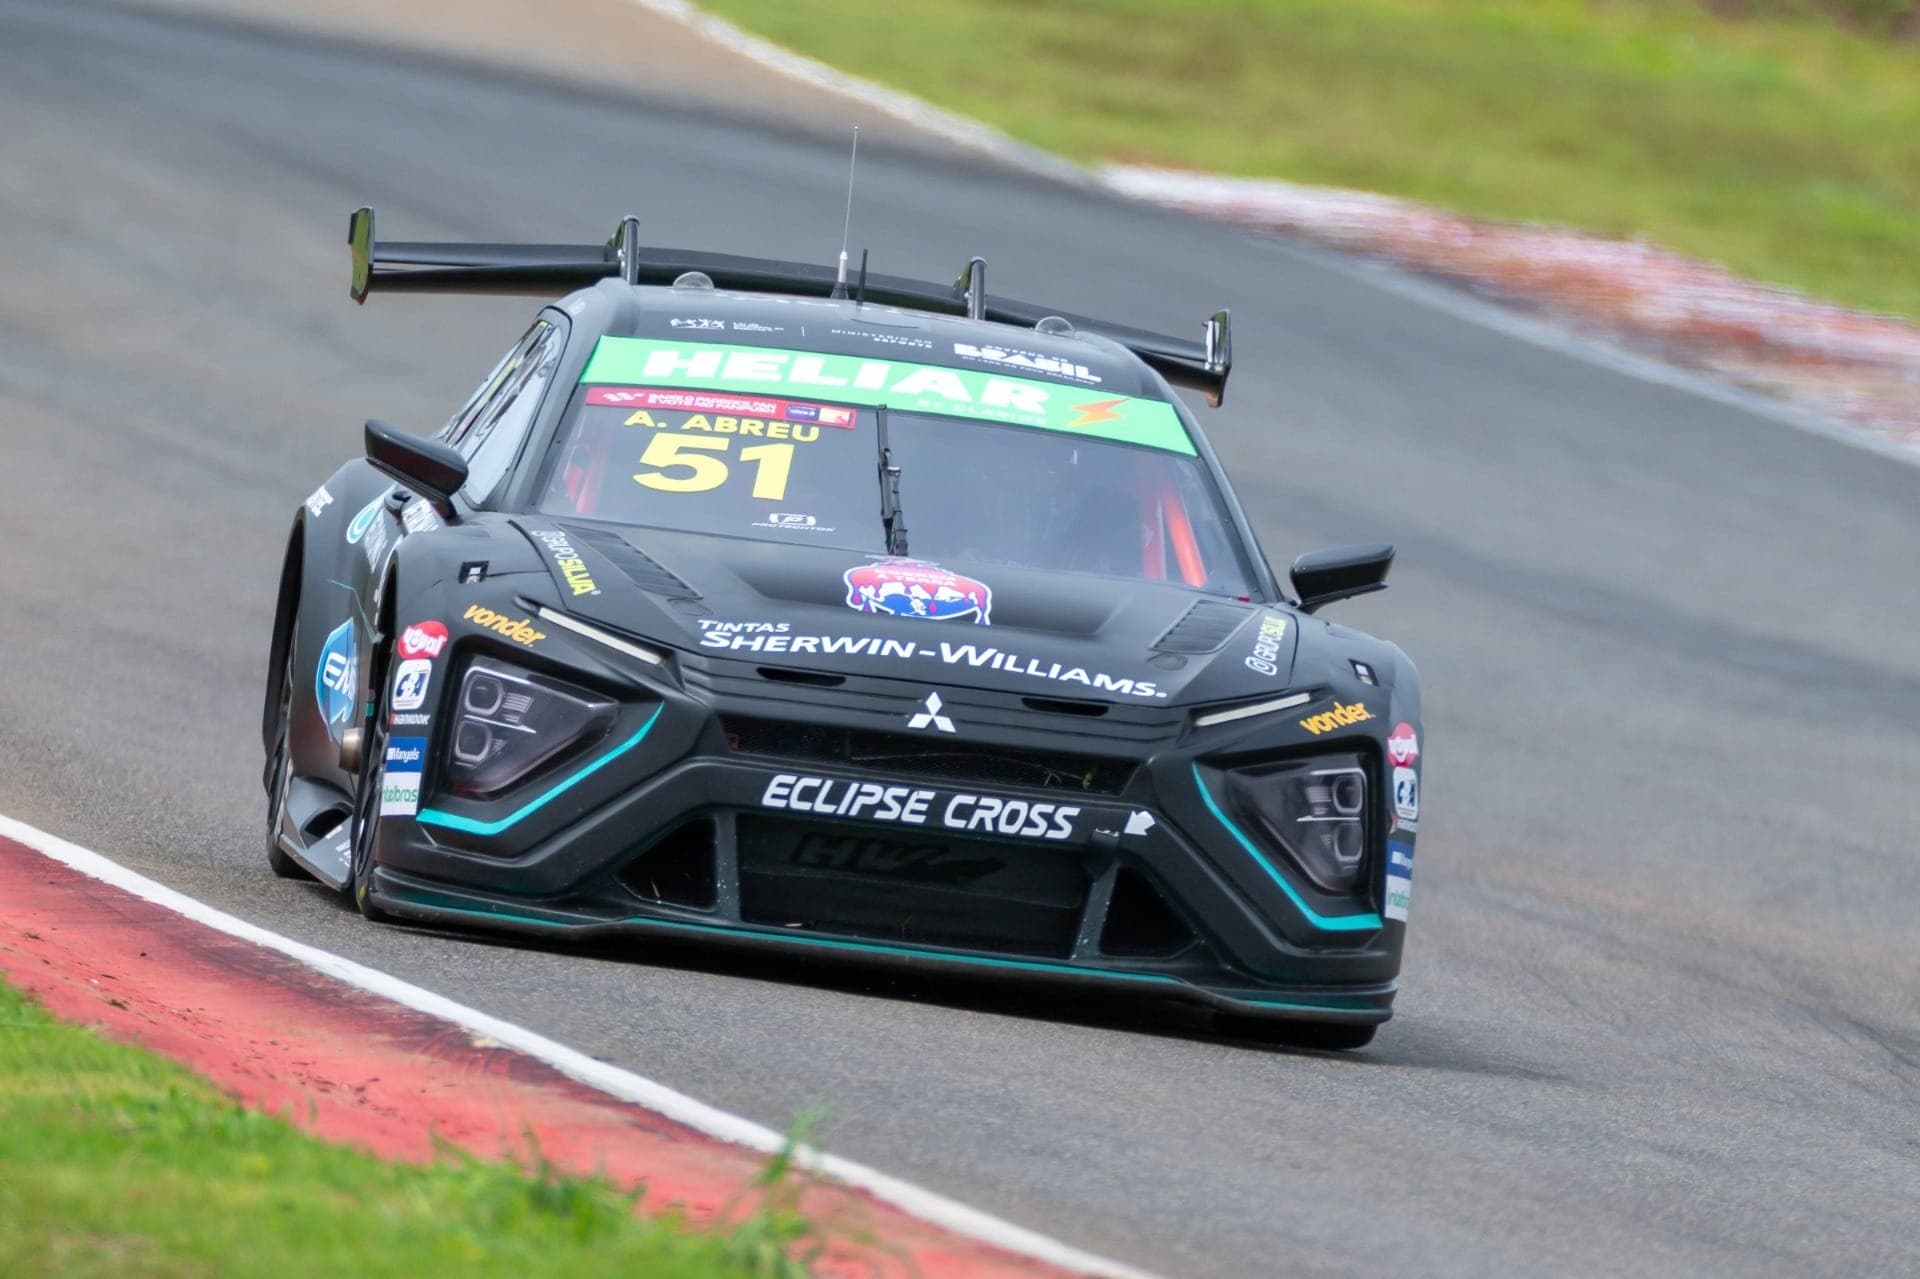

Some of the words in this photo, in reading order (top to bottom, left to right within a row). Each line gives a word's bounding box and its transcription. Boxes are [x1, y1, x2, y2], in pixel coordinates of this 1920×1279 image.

[643, 349, 1051, 414] HELIAR
[953, 343, 1102, 382] BRASIL
[623, 410, 668, 428] A.
[681, 413, 820, 442] ABREU
[632, 432, 796, 501] 51
[697, 619, 791, 634] TINTAS
[761, 774, 937, 825] ECLIPSE
[943, 794, 1081, 840] CROSS
